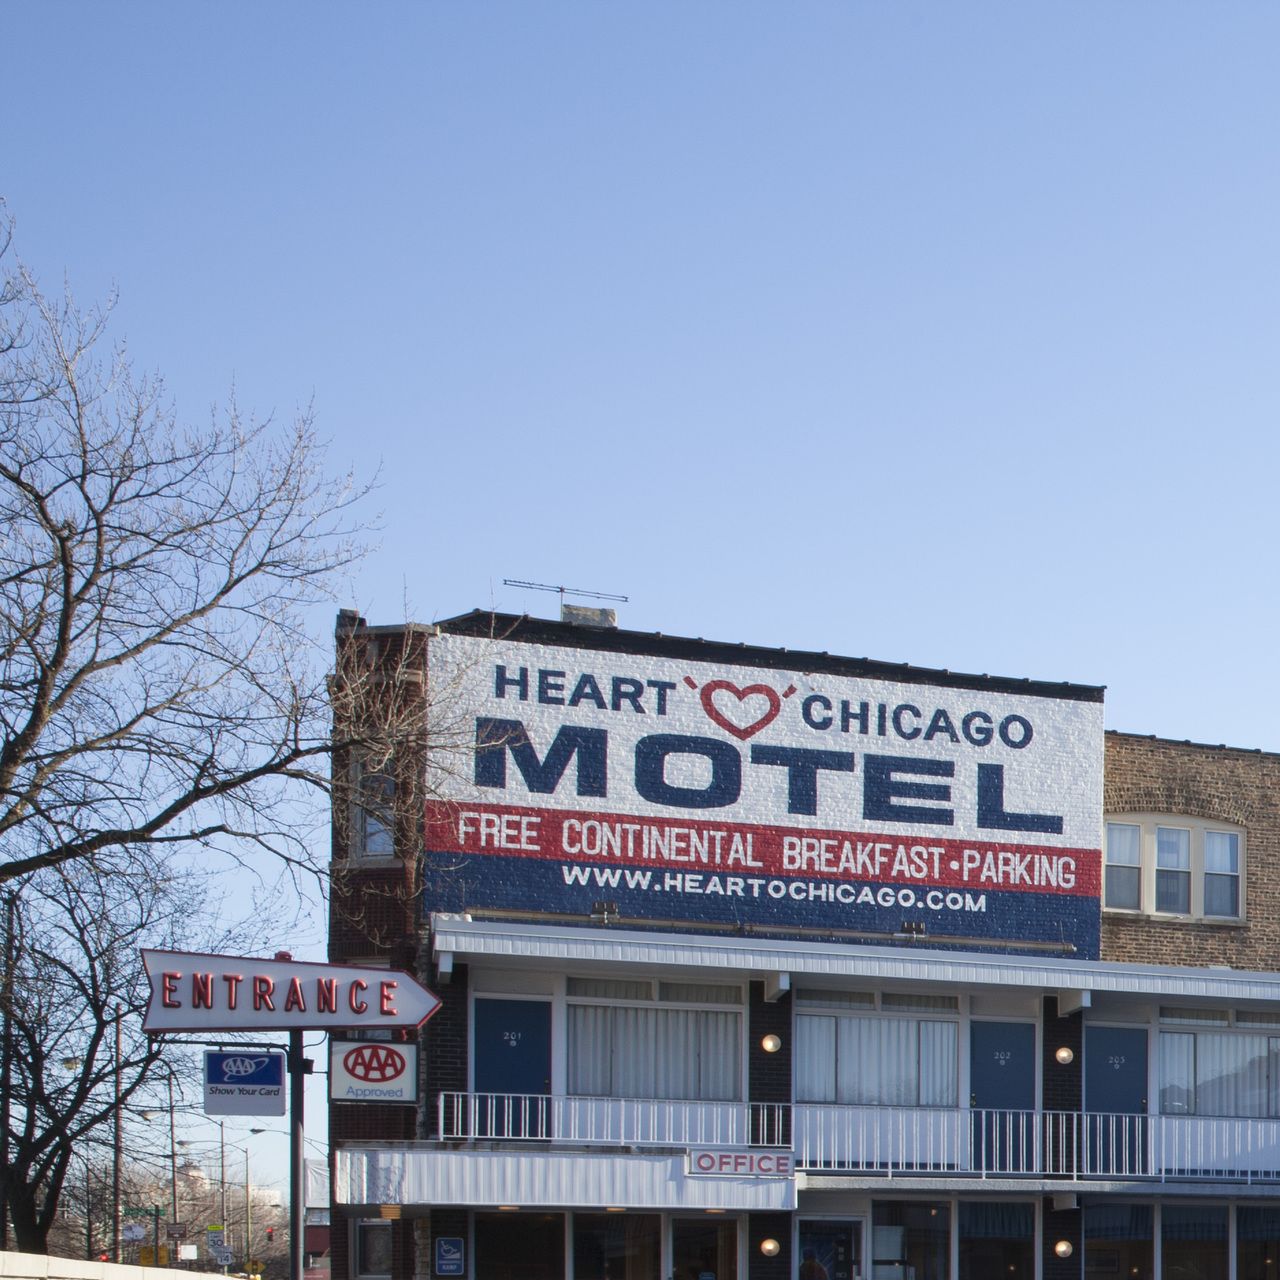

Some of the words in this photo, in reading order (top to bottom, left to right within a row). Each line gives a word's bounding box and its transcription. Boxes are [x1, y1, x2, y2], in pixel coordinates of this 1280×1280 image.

[495, 664, 677, 716] HEART
[801, 694, 1034, 750] CHICAGO
[474, 716, 1064, 835] MOTEL
[458, 811, 541, 851] FREE
[561, 818, 763, 867] CONTINENTAL
[562, 865, 987, 913] WWW.HEARTOCHICAGO.COM
[162, 971, 399, 1016] ENTRANCE
[503, 1031, 522, 1040] 201
[226, 1059, 251, 1074] AAA
[350, 1048, 399, 1080] AAA
[208, 1086, 235, 1096] Show
[237, 1086, 257, 1096] Your
[258, 1087, 280, 1097] Card
[346, 1086, 403, 1099] Approved
[697, 1153, 790, 1173] OFFICE
[210, 1239, 223, 1247] 30
